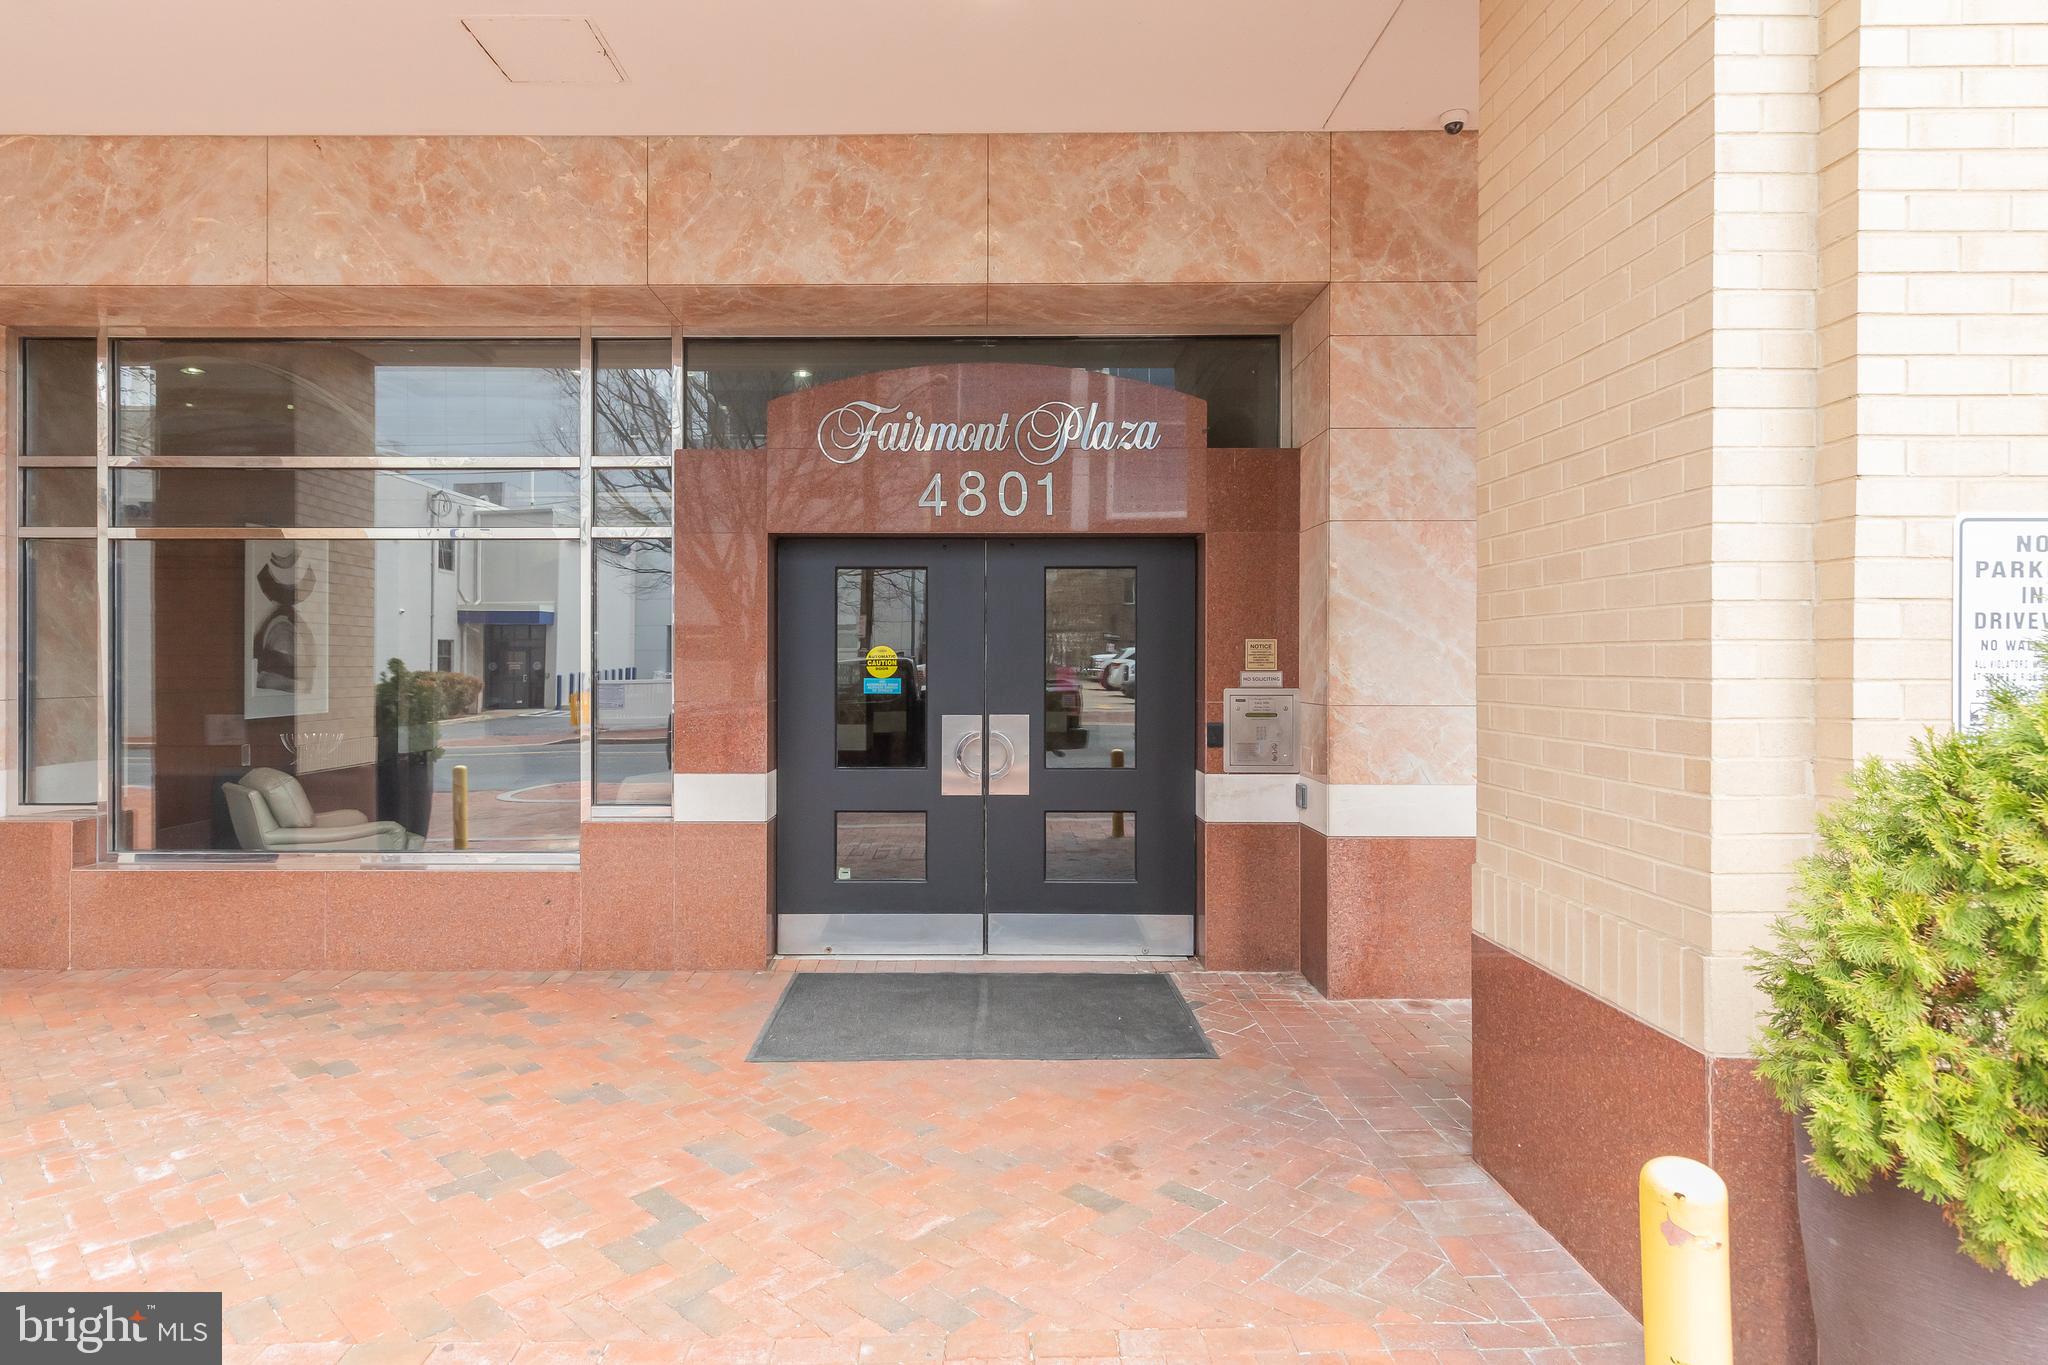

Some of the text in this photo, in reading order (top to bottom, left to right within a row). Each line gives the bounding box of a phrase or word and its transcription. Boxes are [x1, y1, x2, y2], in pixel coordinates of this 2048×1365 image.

[817, 400, 1161, 466] Fairmont Plaza
[918, 470, 1054, 517] 4801
[2016, 535, 2048, 553] NO
[1975, 560, 2048, 578] PARK
[2022, 586, 2043, 604] IN
[1981, 640, 1998, 651] NO
